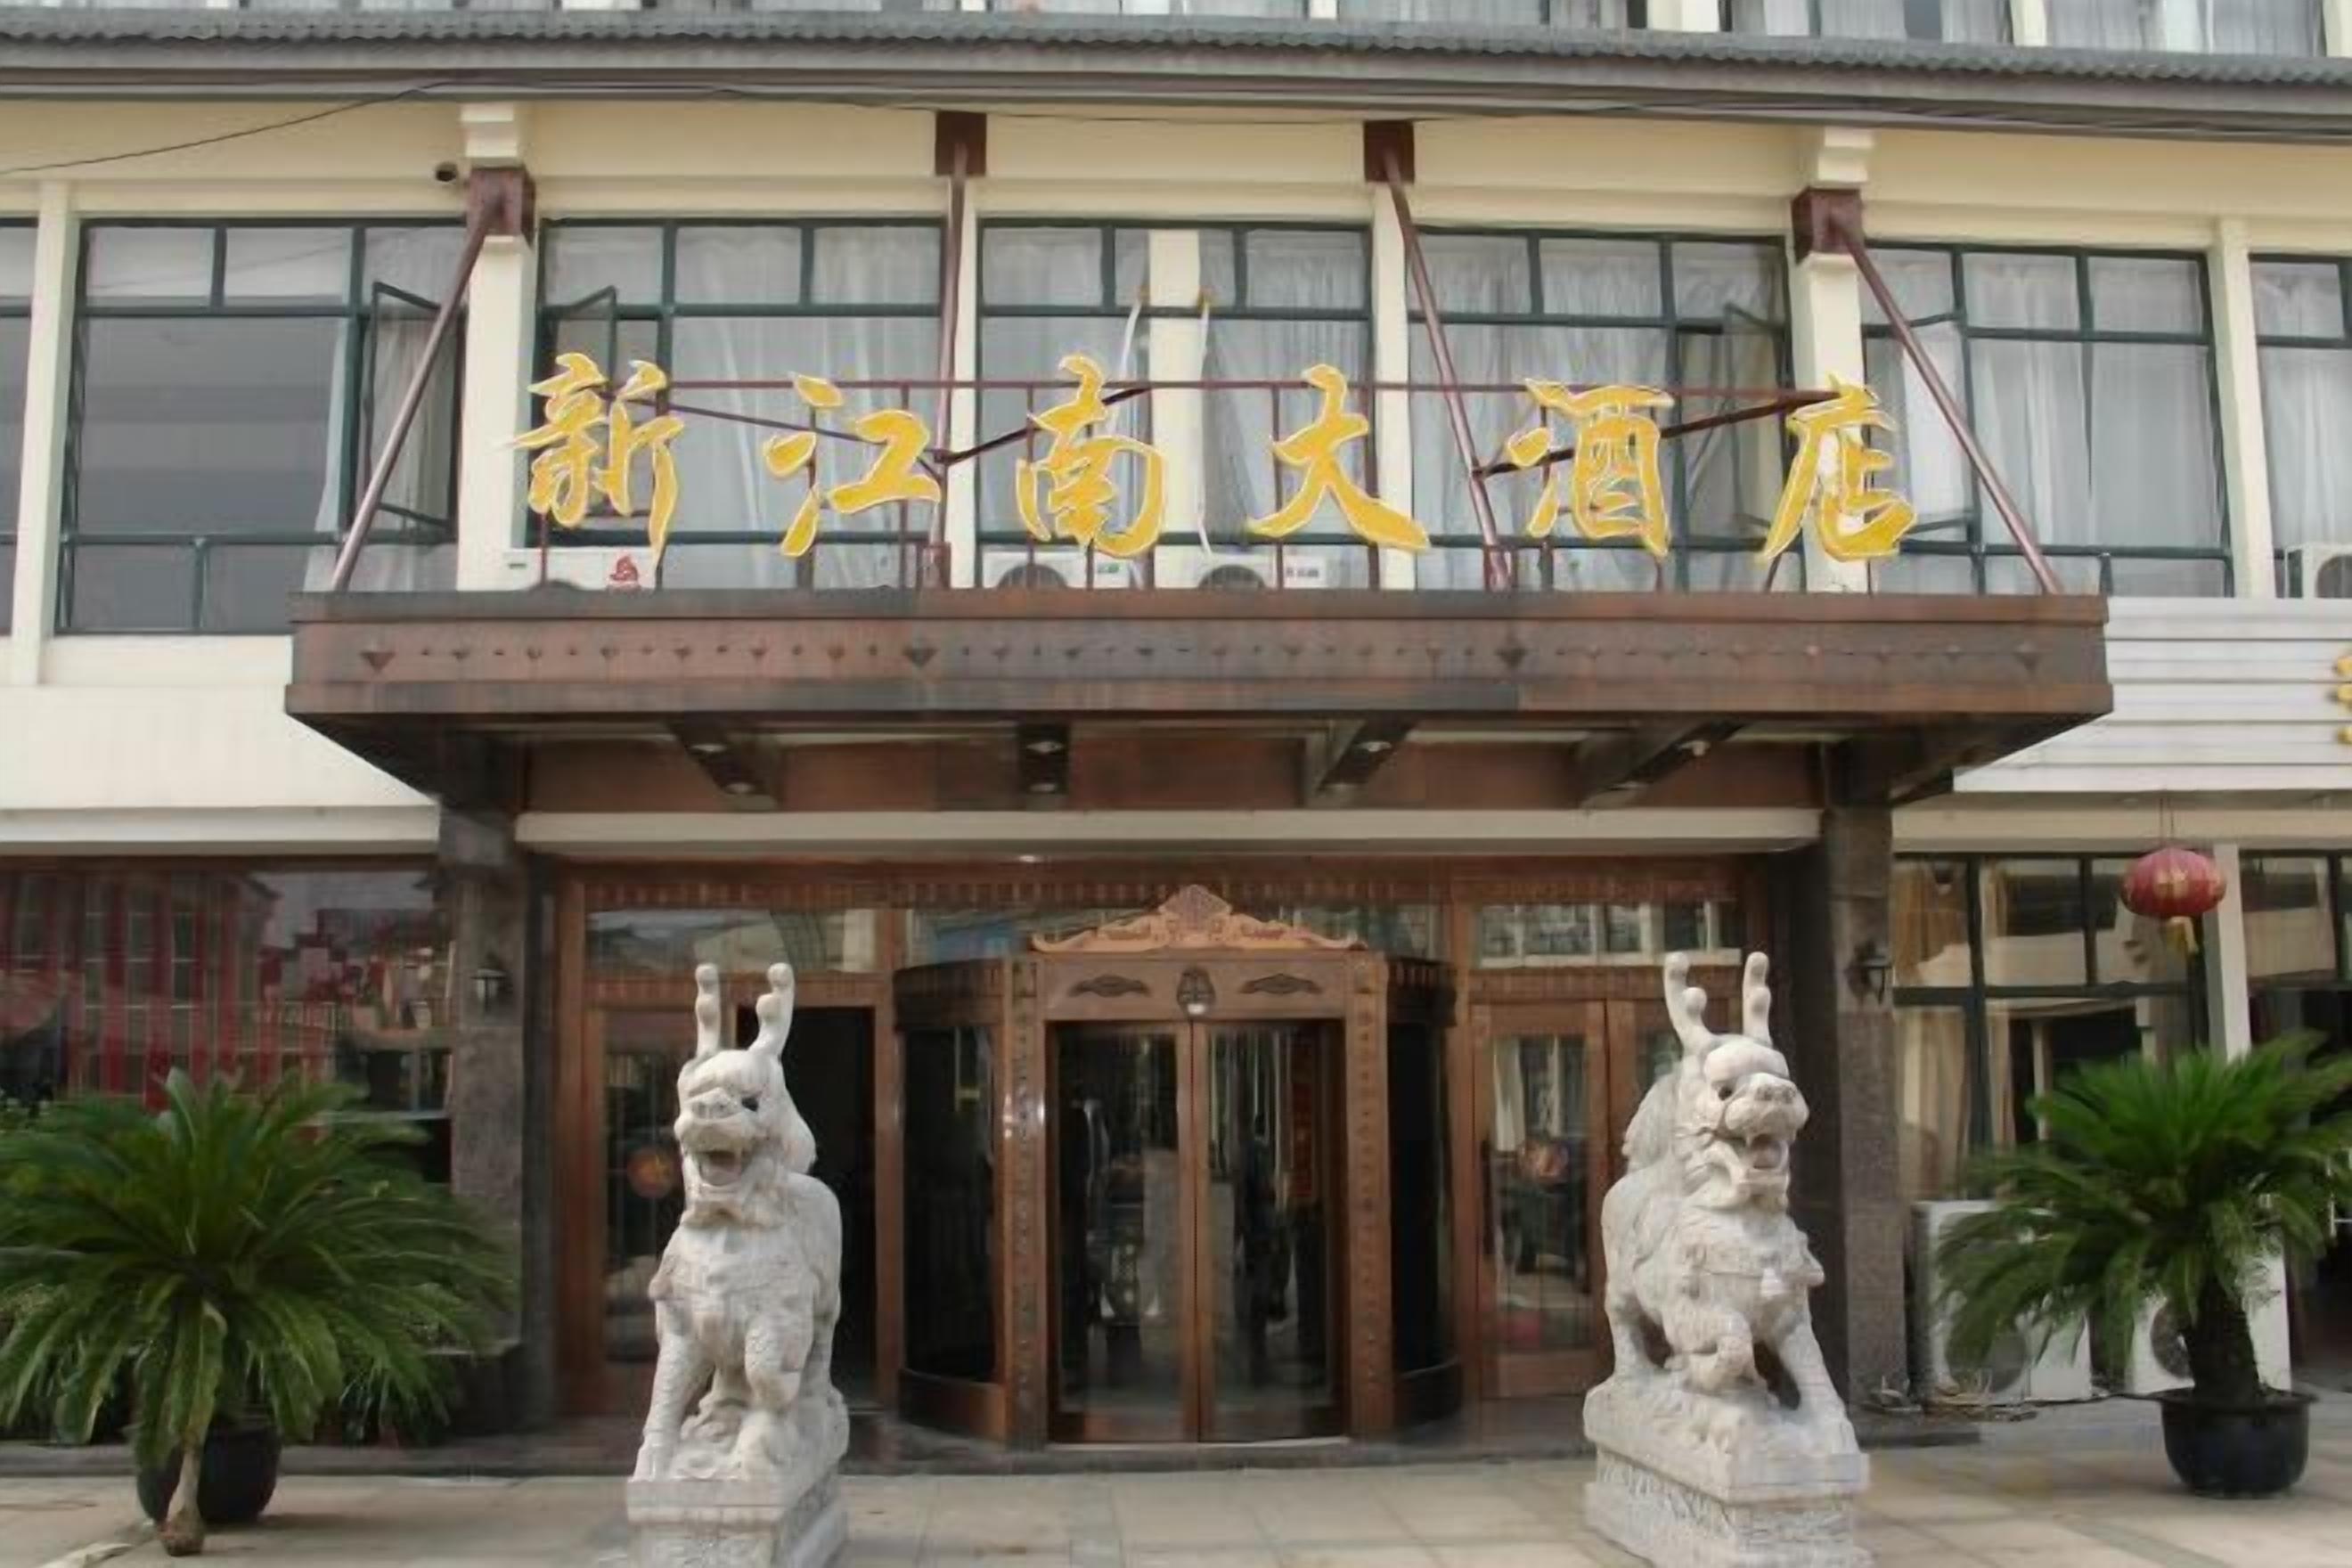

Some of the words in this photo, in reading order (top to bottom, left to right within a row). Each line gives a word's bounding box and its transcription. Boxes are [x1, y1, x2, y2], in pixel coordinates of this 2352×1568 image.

[513, 352, 1915, 565] 新江南大酒店
